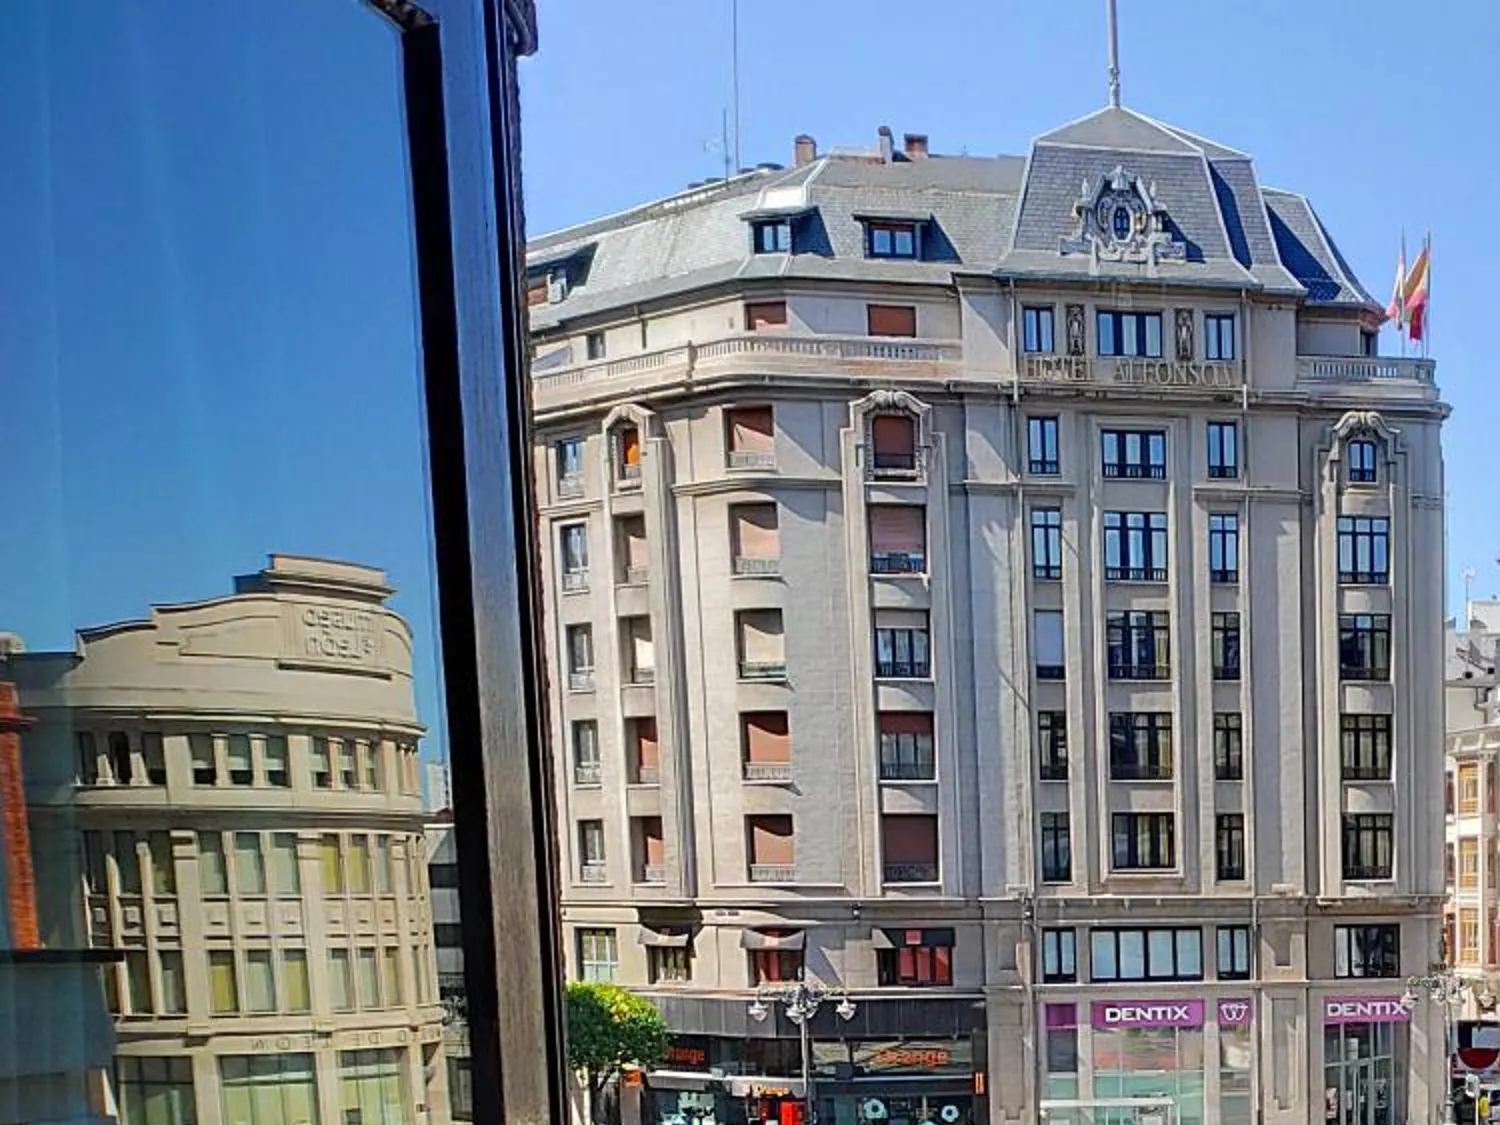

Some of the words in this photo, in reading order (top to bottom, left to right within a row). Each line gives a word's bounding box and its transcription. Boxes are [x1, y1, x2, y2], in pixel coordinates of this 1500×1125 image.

[1026, 356, 1094, 380] HOTEL
[1105, 1005, 1189, 1022] DENTIX
[1327, 1002, 1409, 1016] DENTIX
